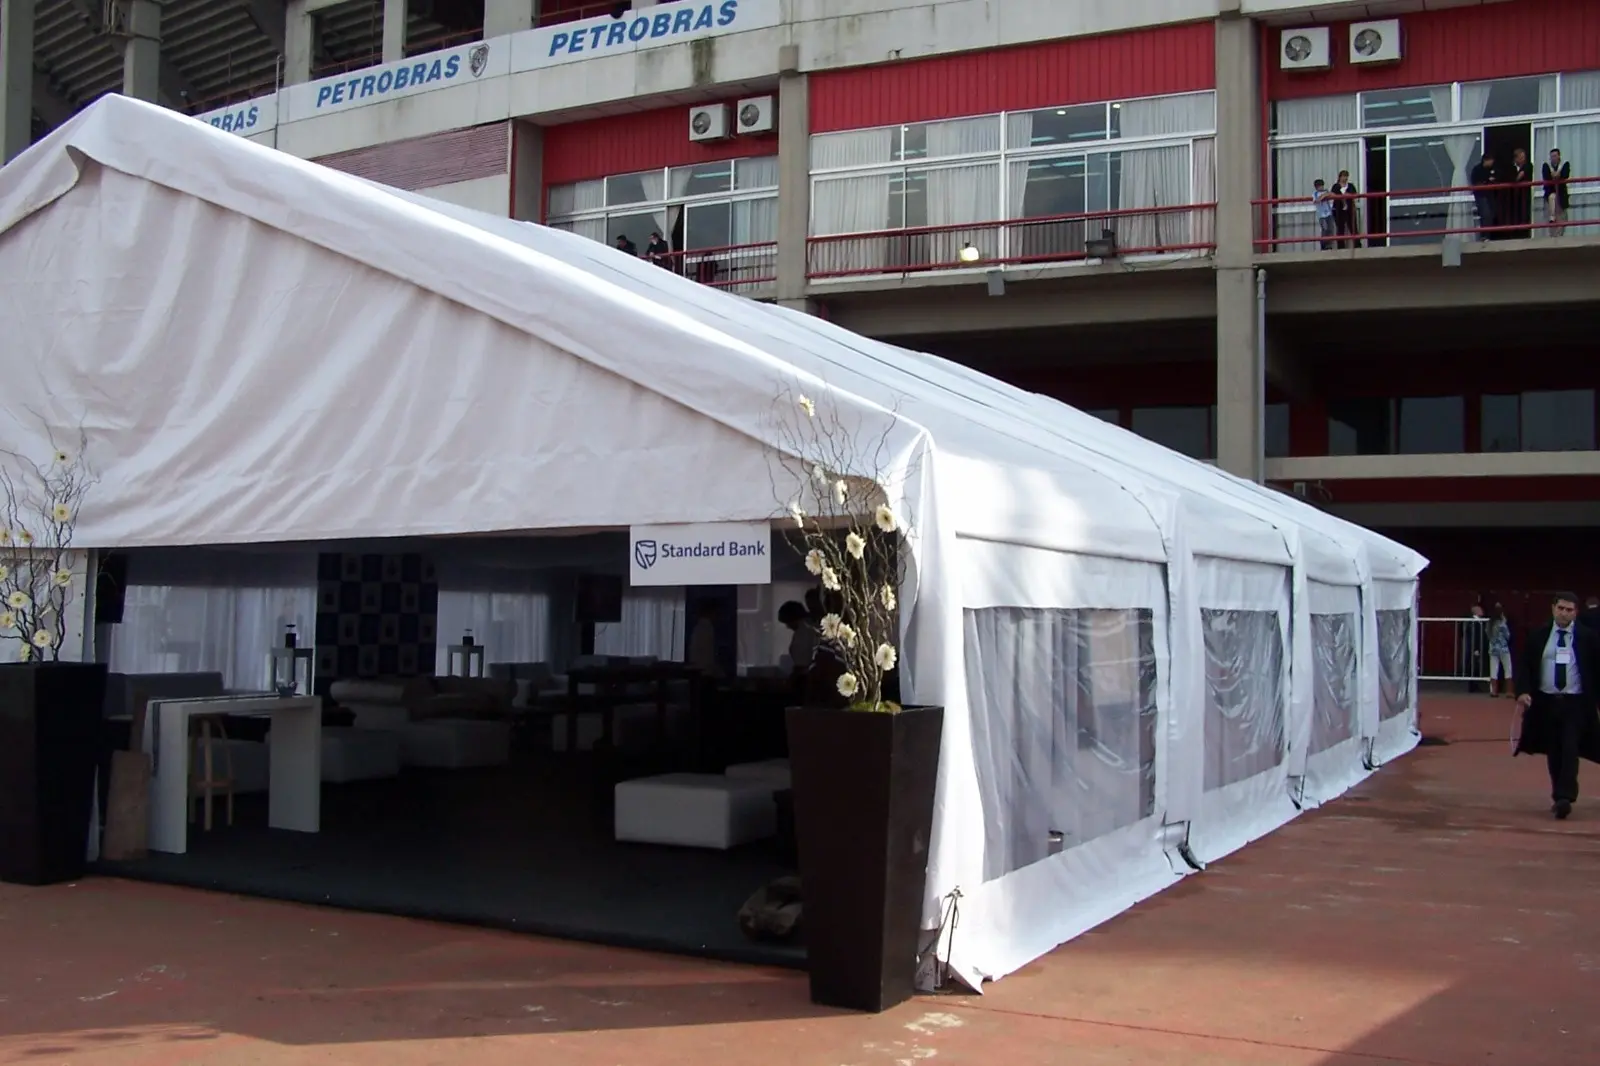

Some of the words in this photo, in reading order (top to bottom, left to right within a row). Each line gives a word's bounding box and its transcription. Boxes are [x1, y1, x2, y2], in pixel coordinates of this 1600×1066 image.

[548, 0, 738, 57] PETROBRAS
[316, 54, 461, 108] PETROBRAS
[204, 106, 259, 132] BRAS
[661, 542, 726, 558] Standard
[729, 540, 766, 557] Bank
